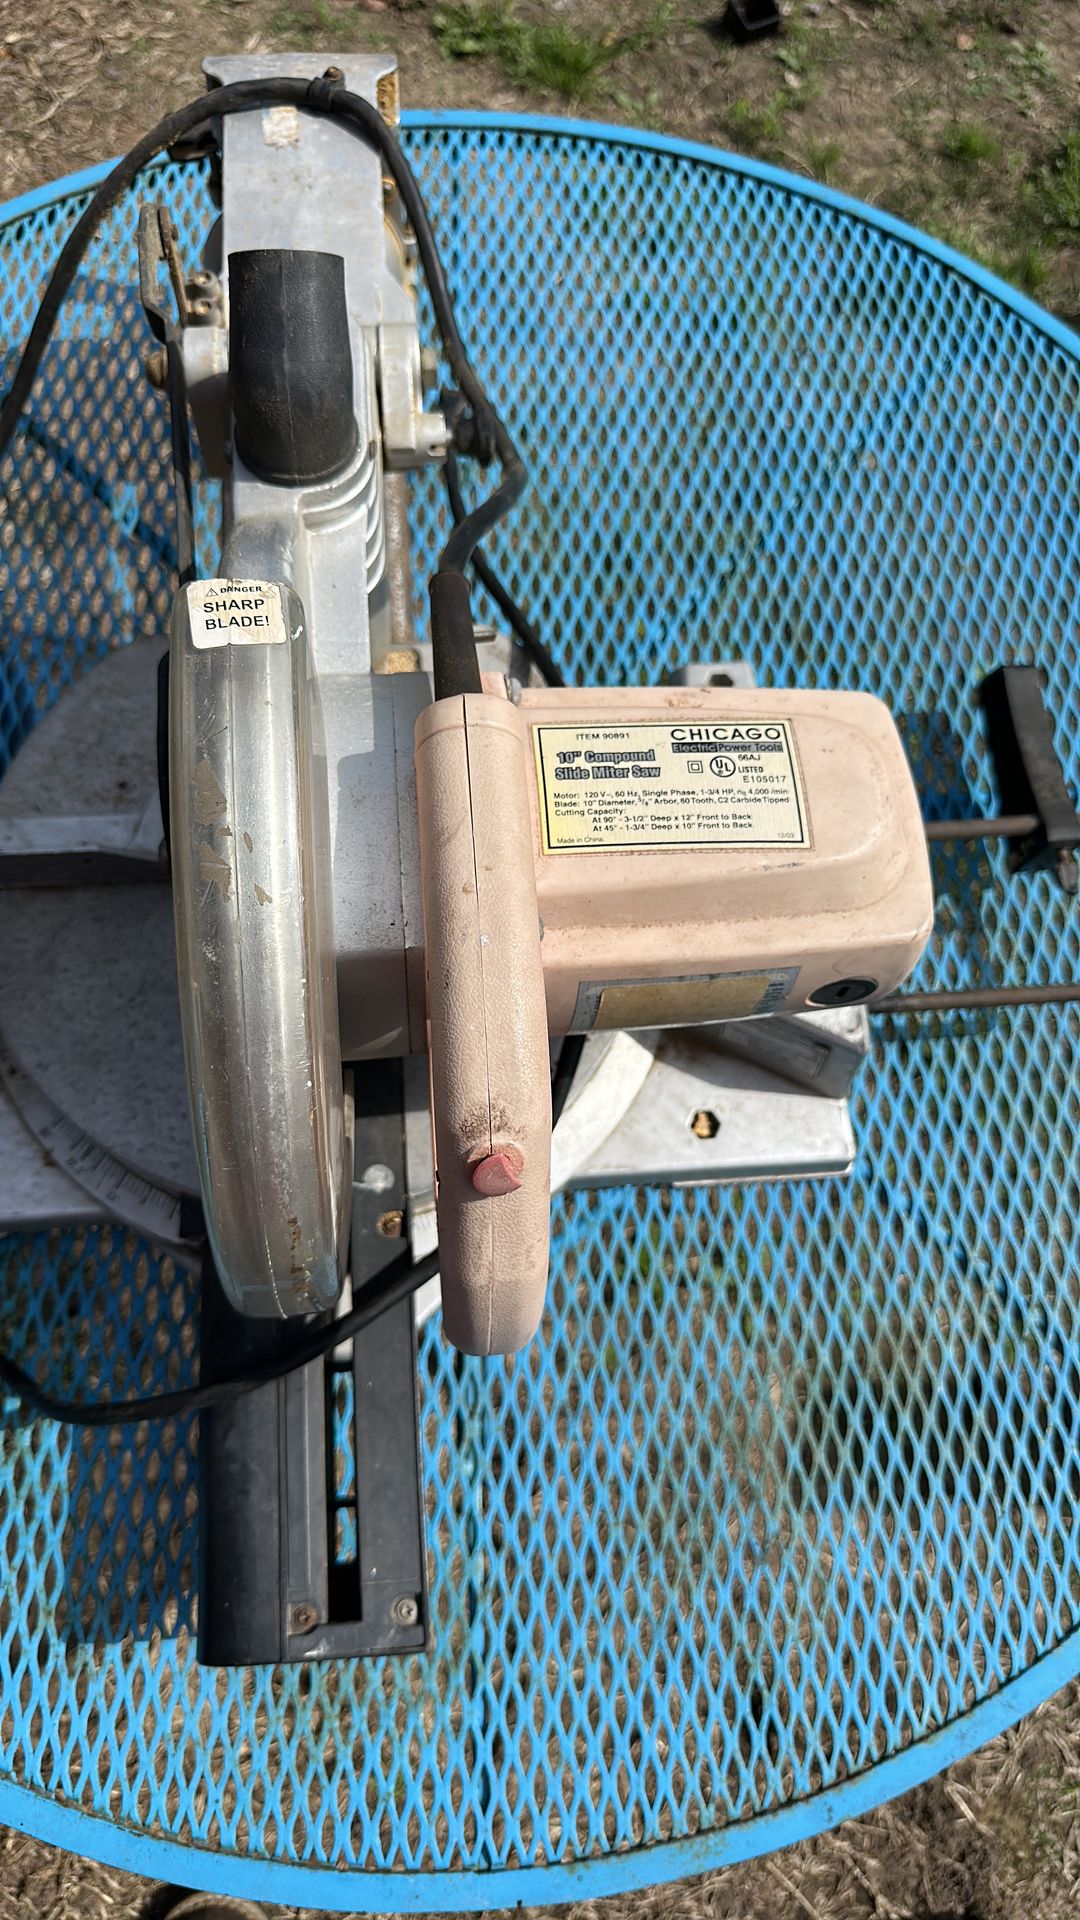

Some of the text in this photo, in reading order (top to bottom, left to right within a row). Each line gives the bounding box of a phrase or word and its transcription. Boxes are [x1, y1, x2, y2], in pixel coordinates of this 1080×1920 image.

[204, 599, 264, 612] SHARP
[206, 616, 269, 630] BLADE!
[670, 728, 780, 740] CHICAGO
[672, 742, 782, 752] Electric Power Tools
[556, 749, 656, 764] 10" Compound
[555, 765, 660, 780] Slide Miter Saw
